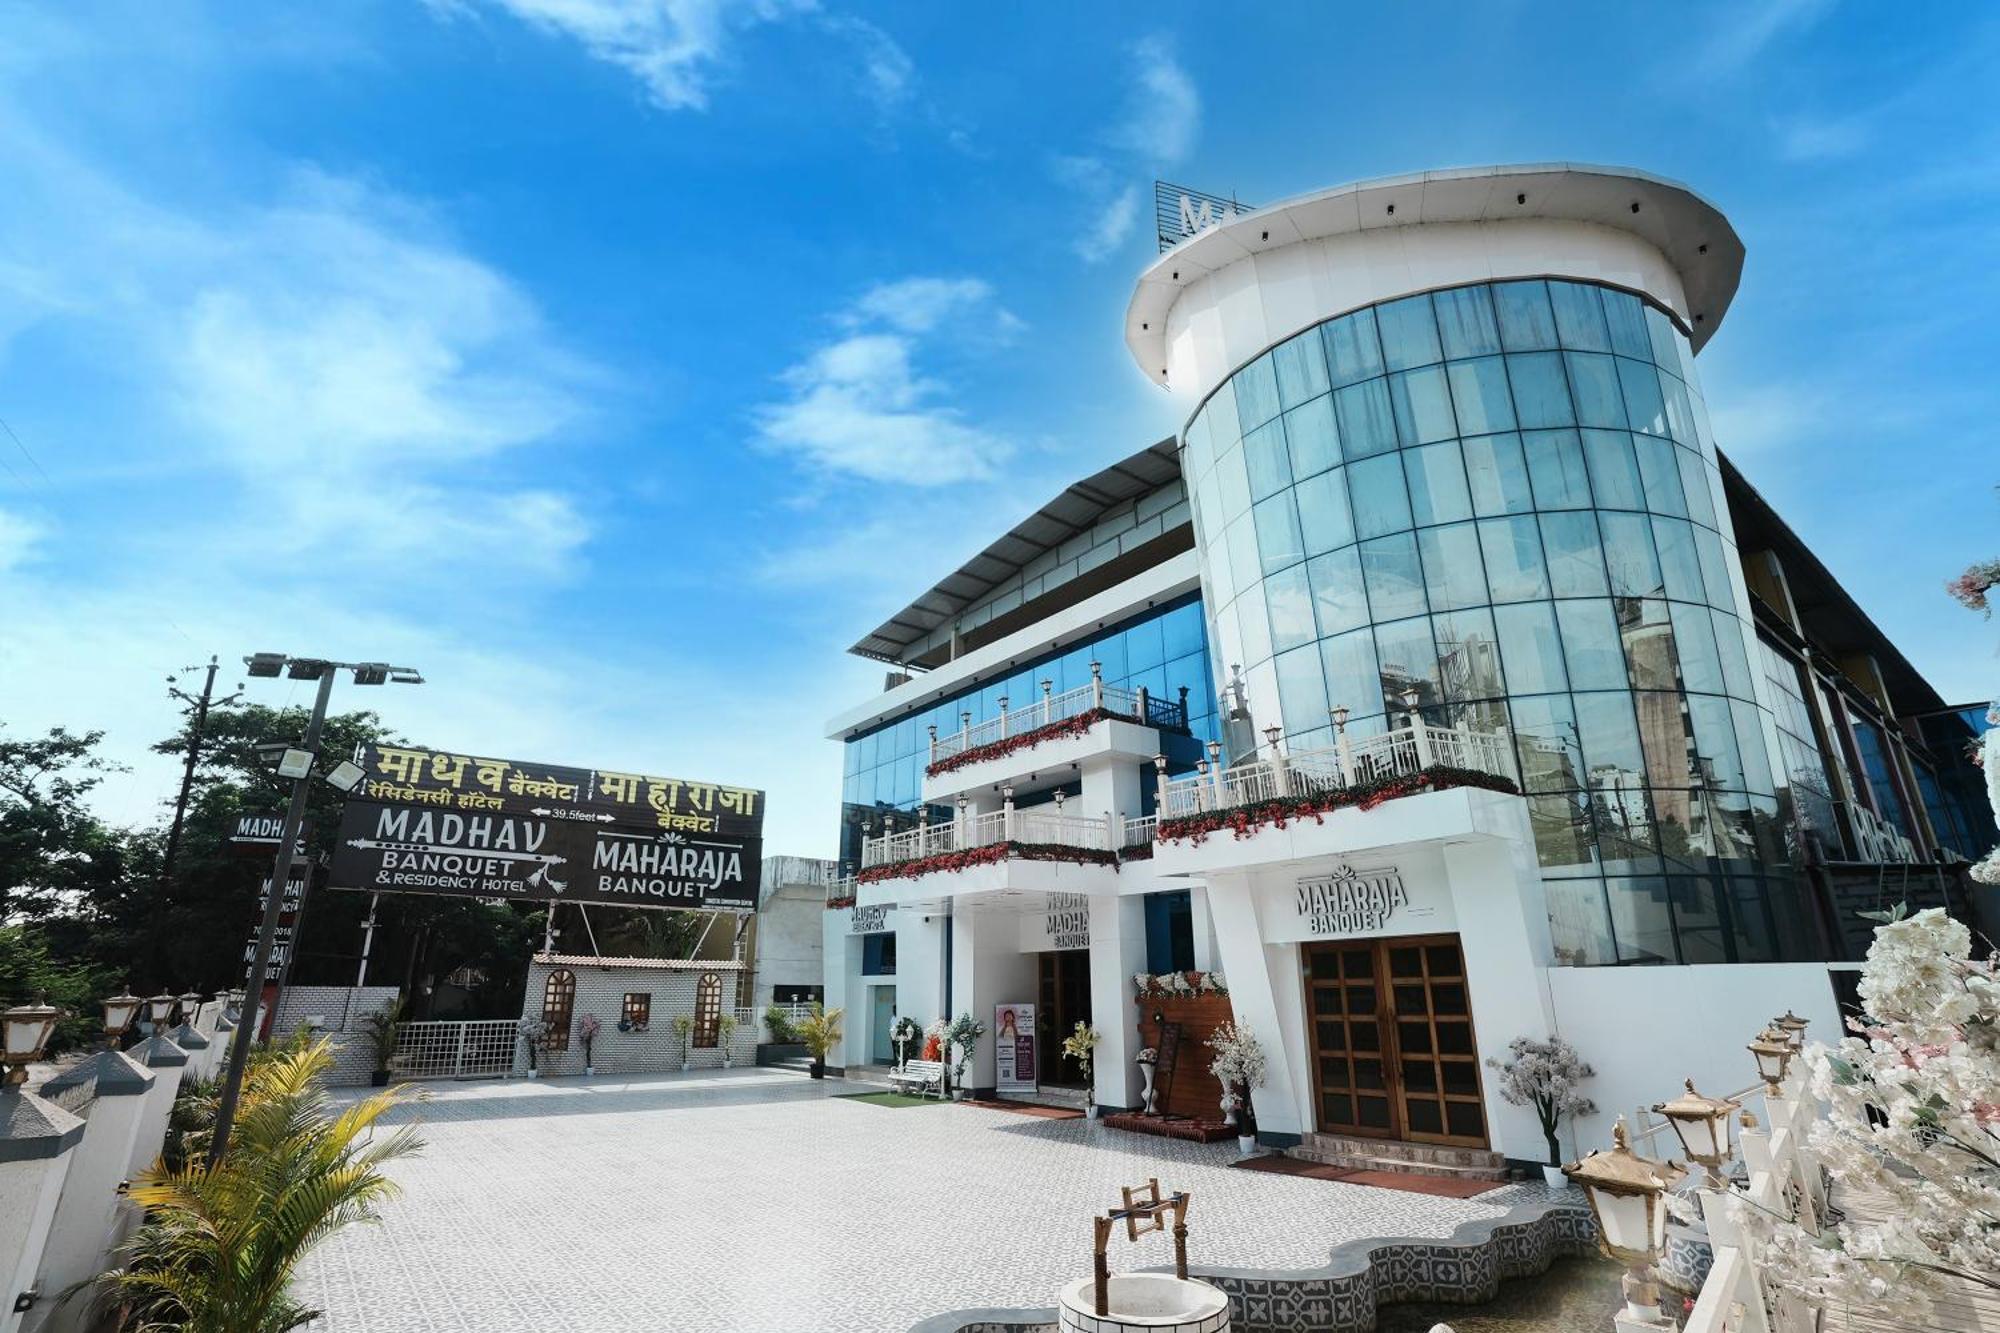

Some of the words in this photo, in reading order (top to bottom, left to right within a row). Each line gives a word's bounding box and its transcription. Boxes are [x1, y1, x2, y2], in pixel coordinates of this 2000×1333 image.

[376, 747, 511, 793] माधव
[236, 817, 303, 838] MADH
[375, 807, 546, 853] MADHAV
[382, 850, 515, 877] BANQUET
[592, 840, 743, 891] MAHARAJA
[375, 870, 392, 885] &
[393, 872, 478, 890] RESIDENCY
[482, 878, 527, 893] HOTEL
[598, 874, 709, 899] BANQUET
[1296, 874, 1409, 920] MAHARAJA
[1310, 909, 1385, 935] BANQUET
